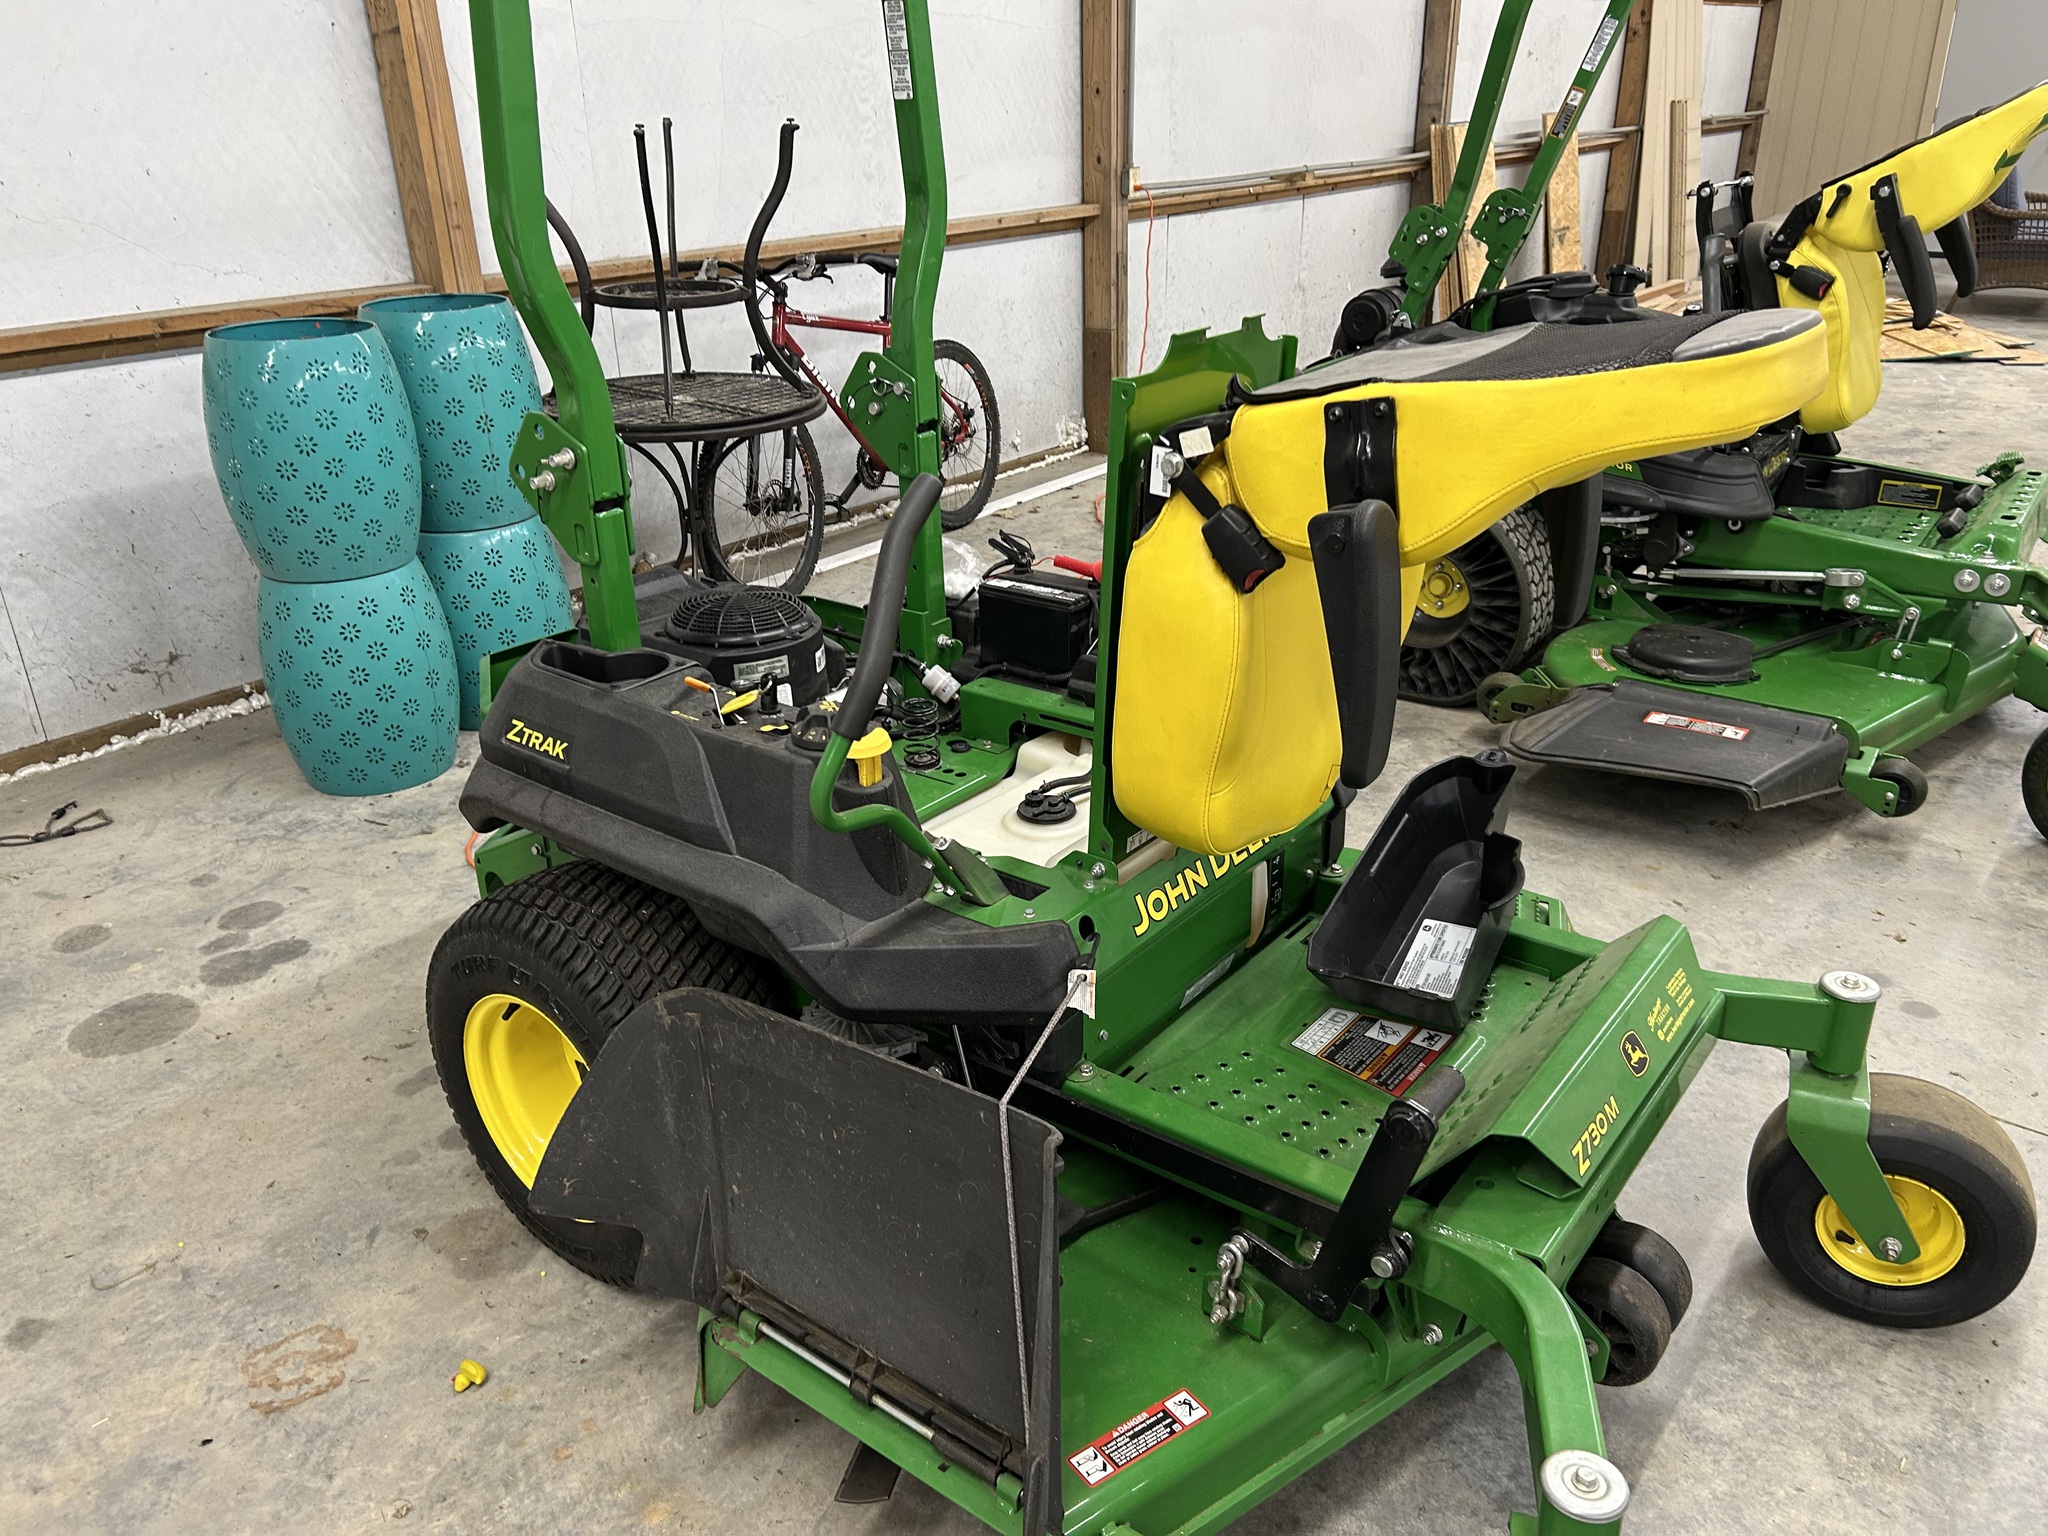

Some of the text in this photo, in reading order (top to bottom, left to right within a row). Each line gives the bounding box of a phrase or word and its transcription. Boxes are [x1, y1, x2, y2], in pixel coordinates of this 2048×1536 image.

[506, 718, 569, 760] ZTRAK
[1133, 859, 1209, 937] JOHN
[1570, 1094, 1620, 1177] Z730M
[1117, 1411, 1150, 1433] DANGER
